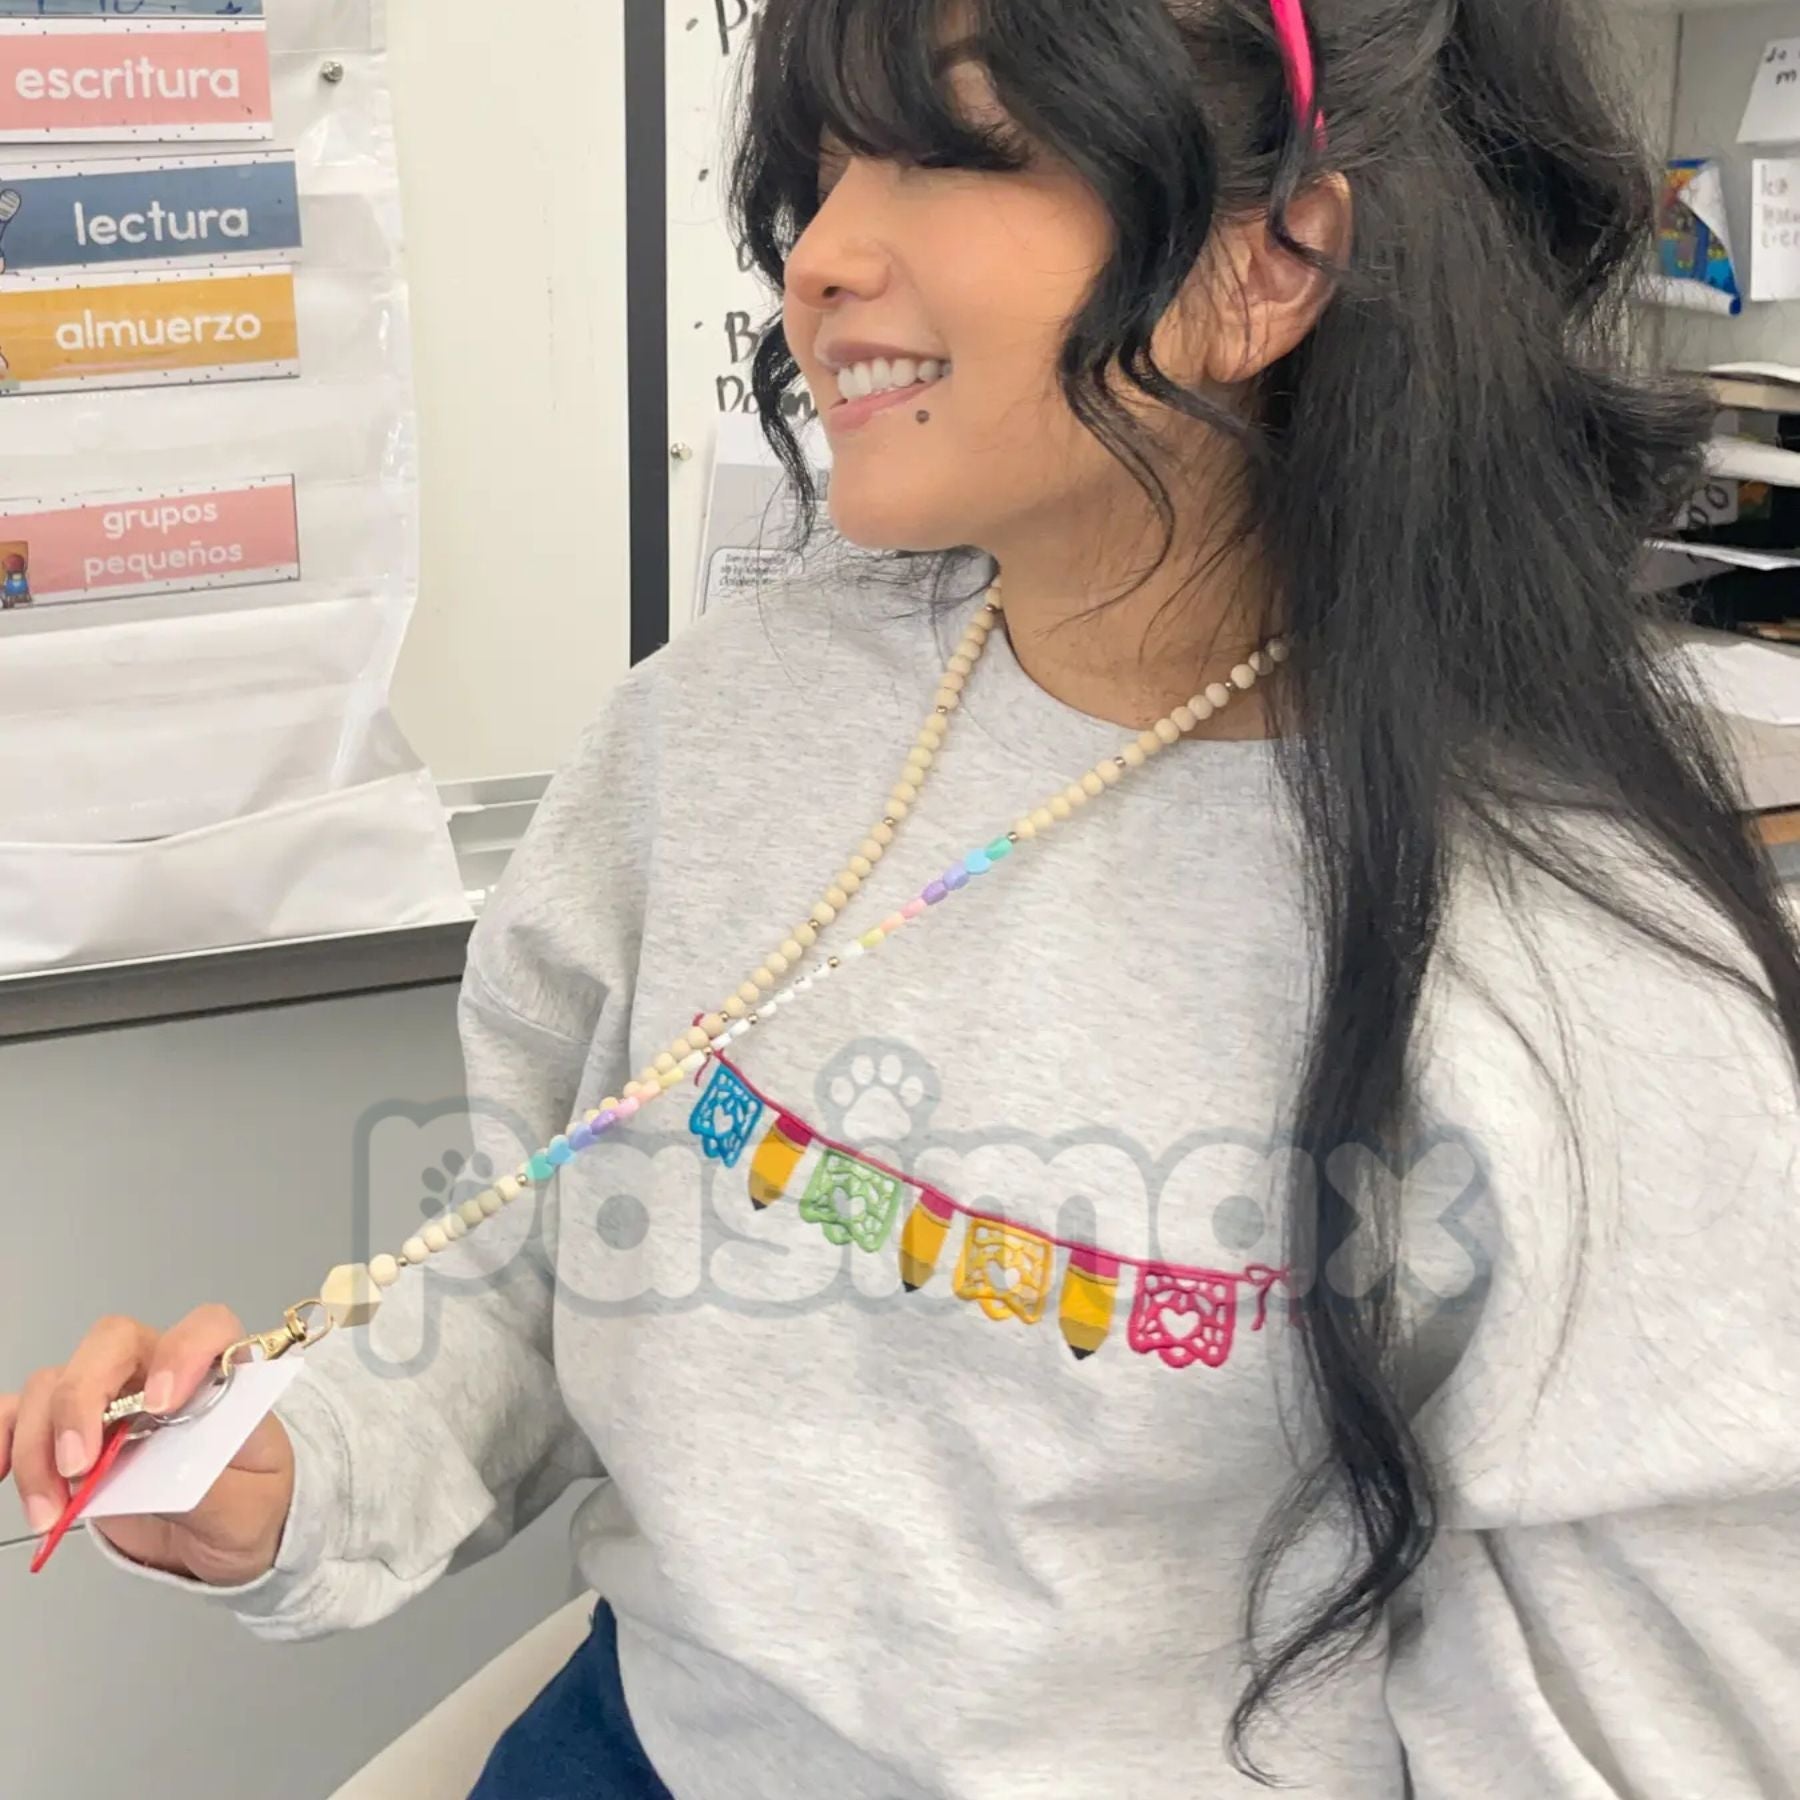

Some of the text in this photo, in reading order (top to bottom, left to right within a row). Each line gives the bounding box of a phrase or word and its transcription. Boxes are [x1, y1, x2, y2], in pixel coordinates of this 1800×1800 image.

[15, 56, 240, 101] escritura
[74, 200, 249, 247] lectura
[55, 308, 262, 352] almuerzo
[103, 501, 219, 540] grupos
[84, 540, 244, 584] pequeños
